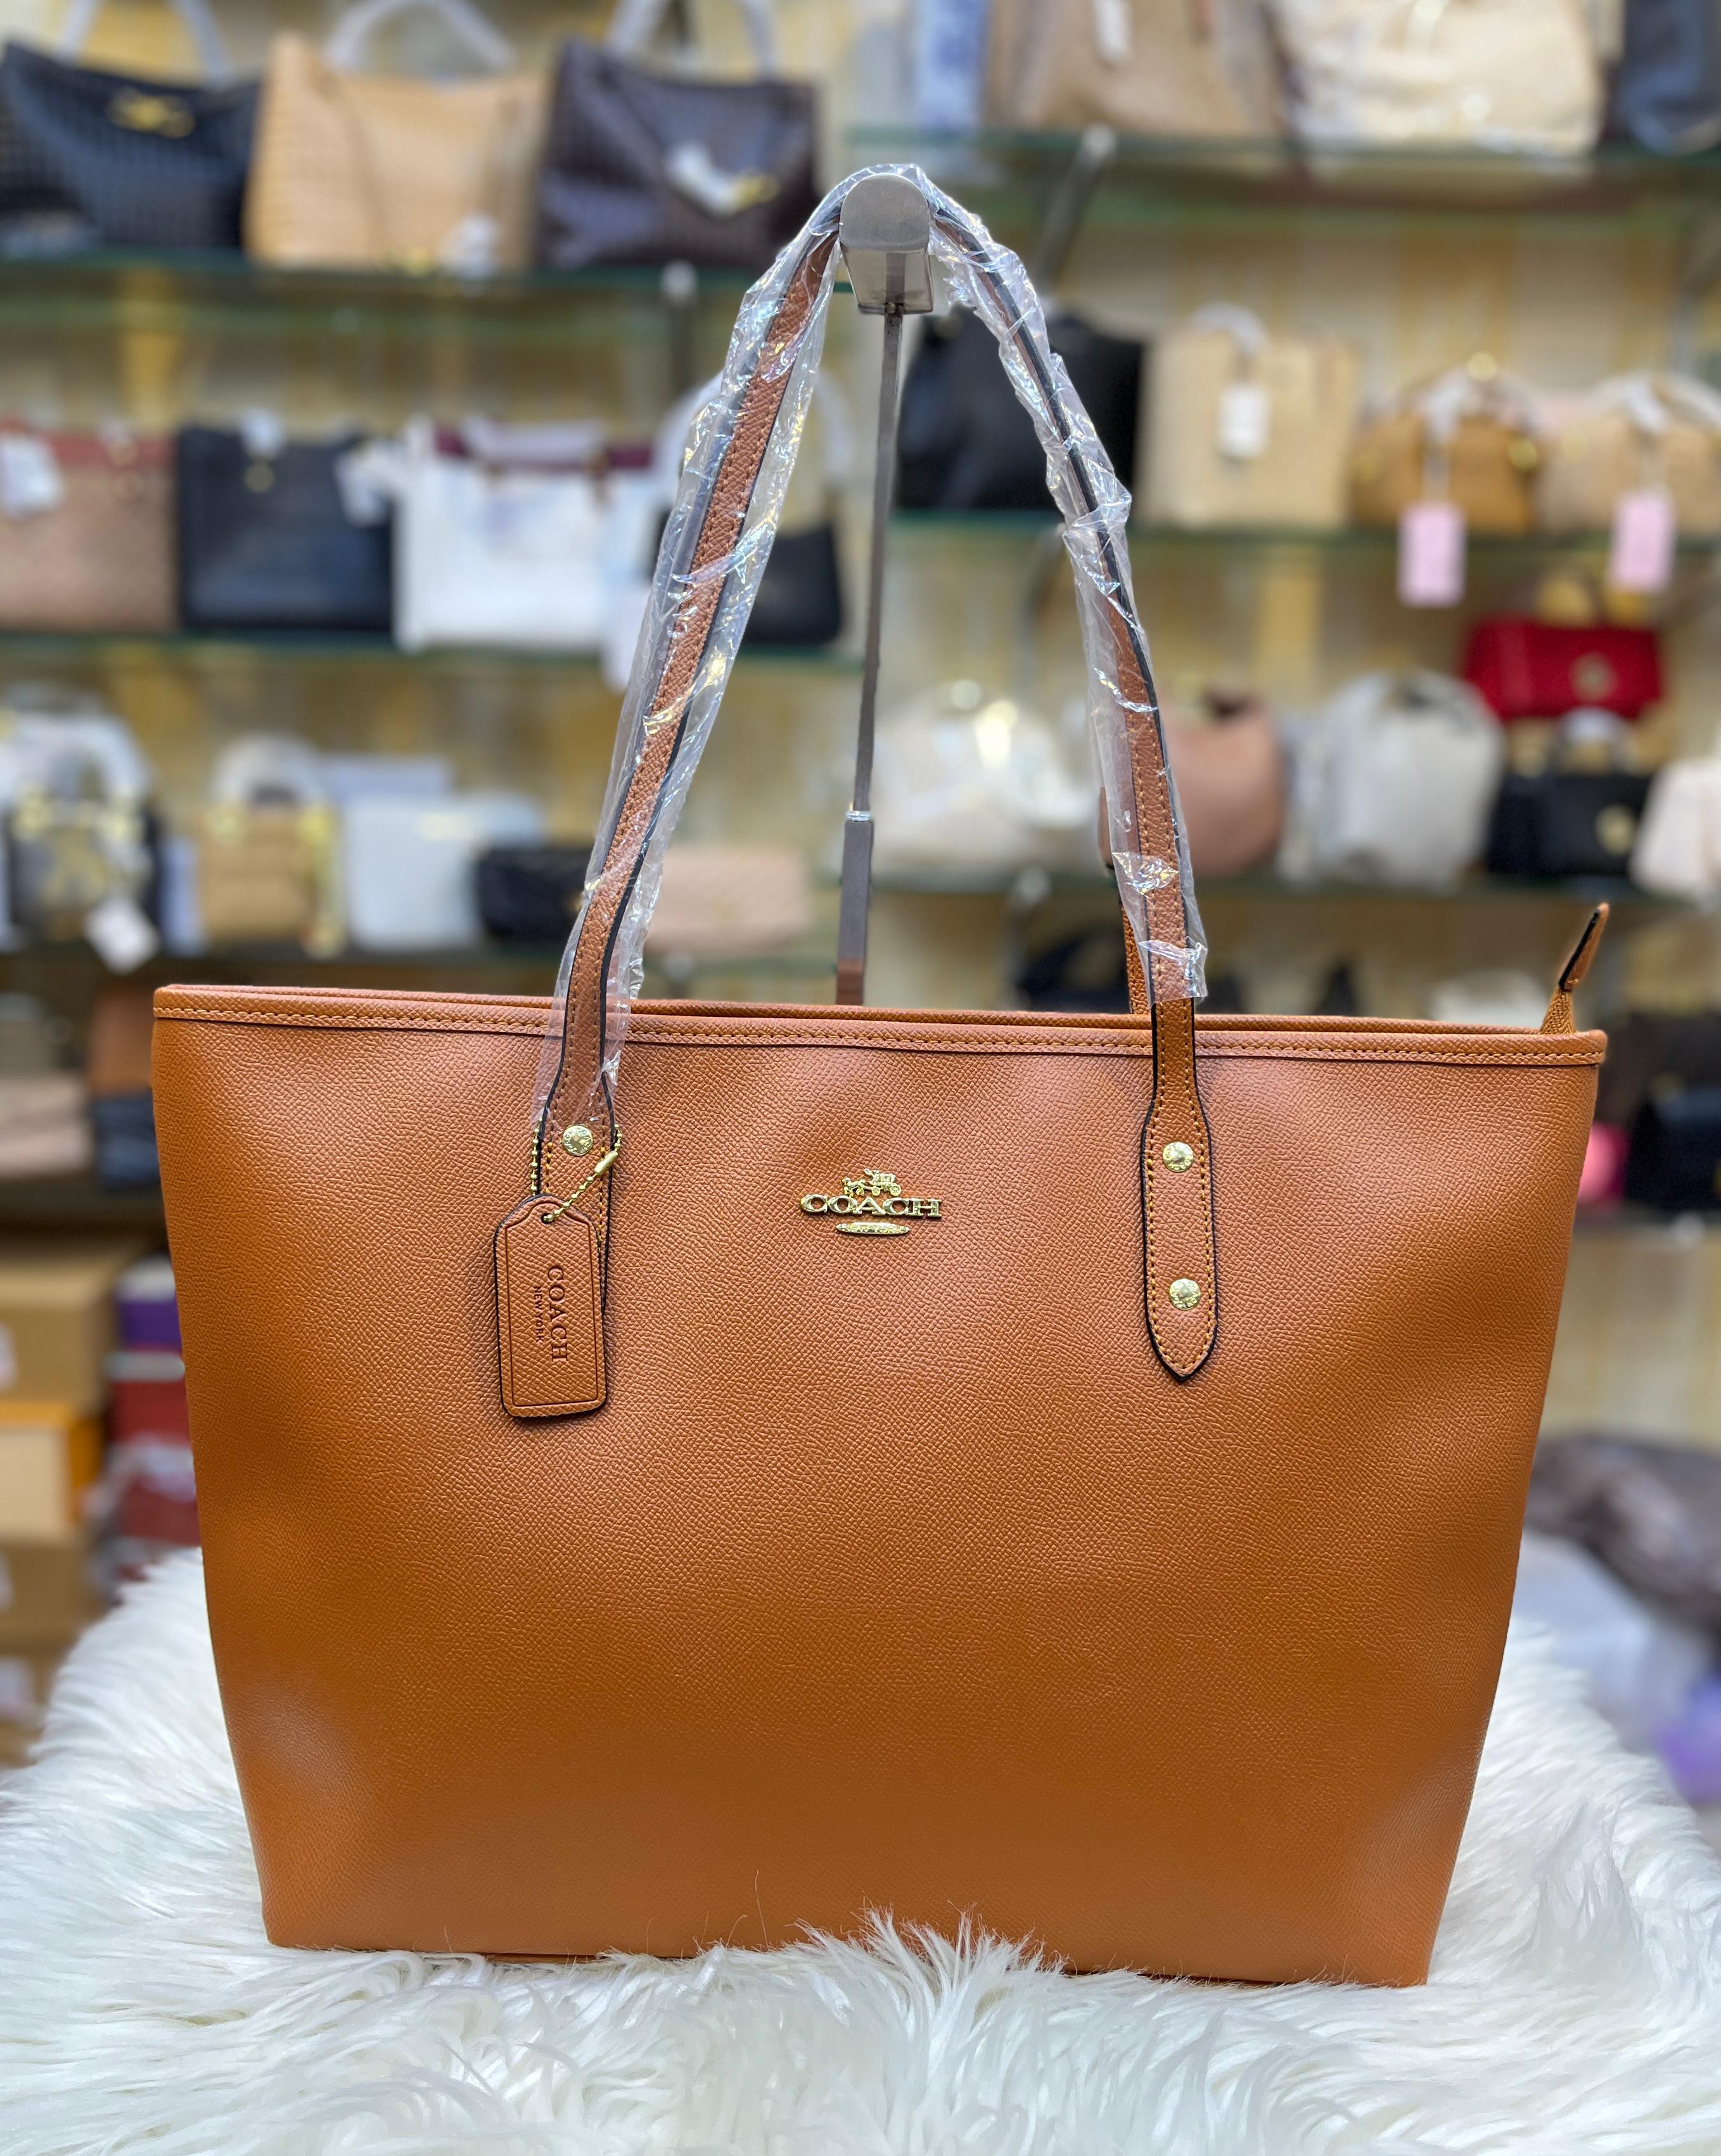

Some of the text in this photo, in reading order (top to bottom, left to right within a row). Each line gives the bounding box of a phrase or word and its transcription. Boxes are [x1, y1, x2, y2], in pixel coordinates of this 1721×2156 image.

[800, 1194, 942, 1217] COACH
[534, 1287, 544, 1343] NEW YORK
[547, 1266, 567, 1362] COACH
